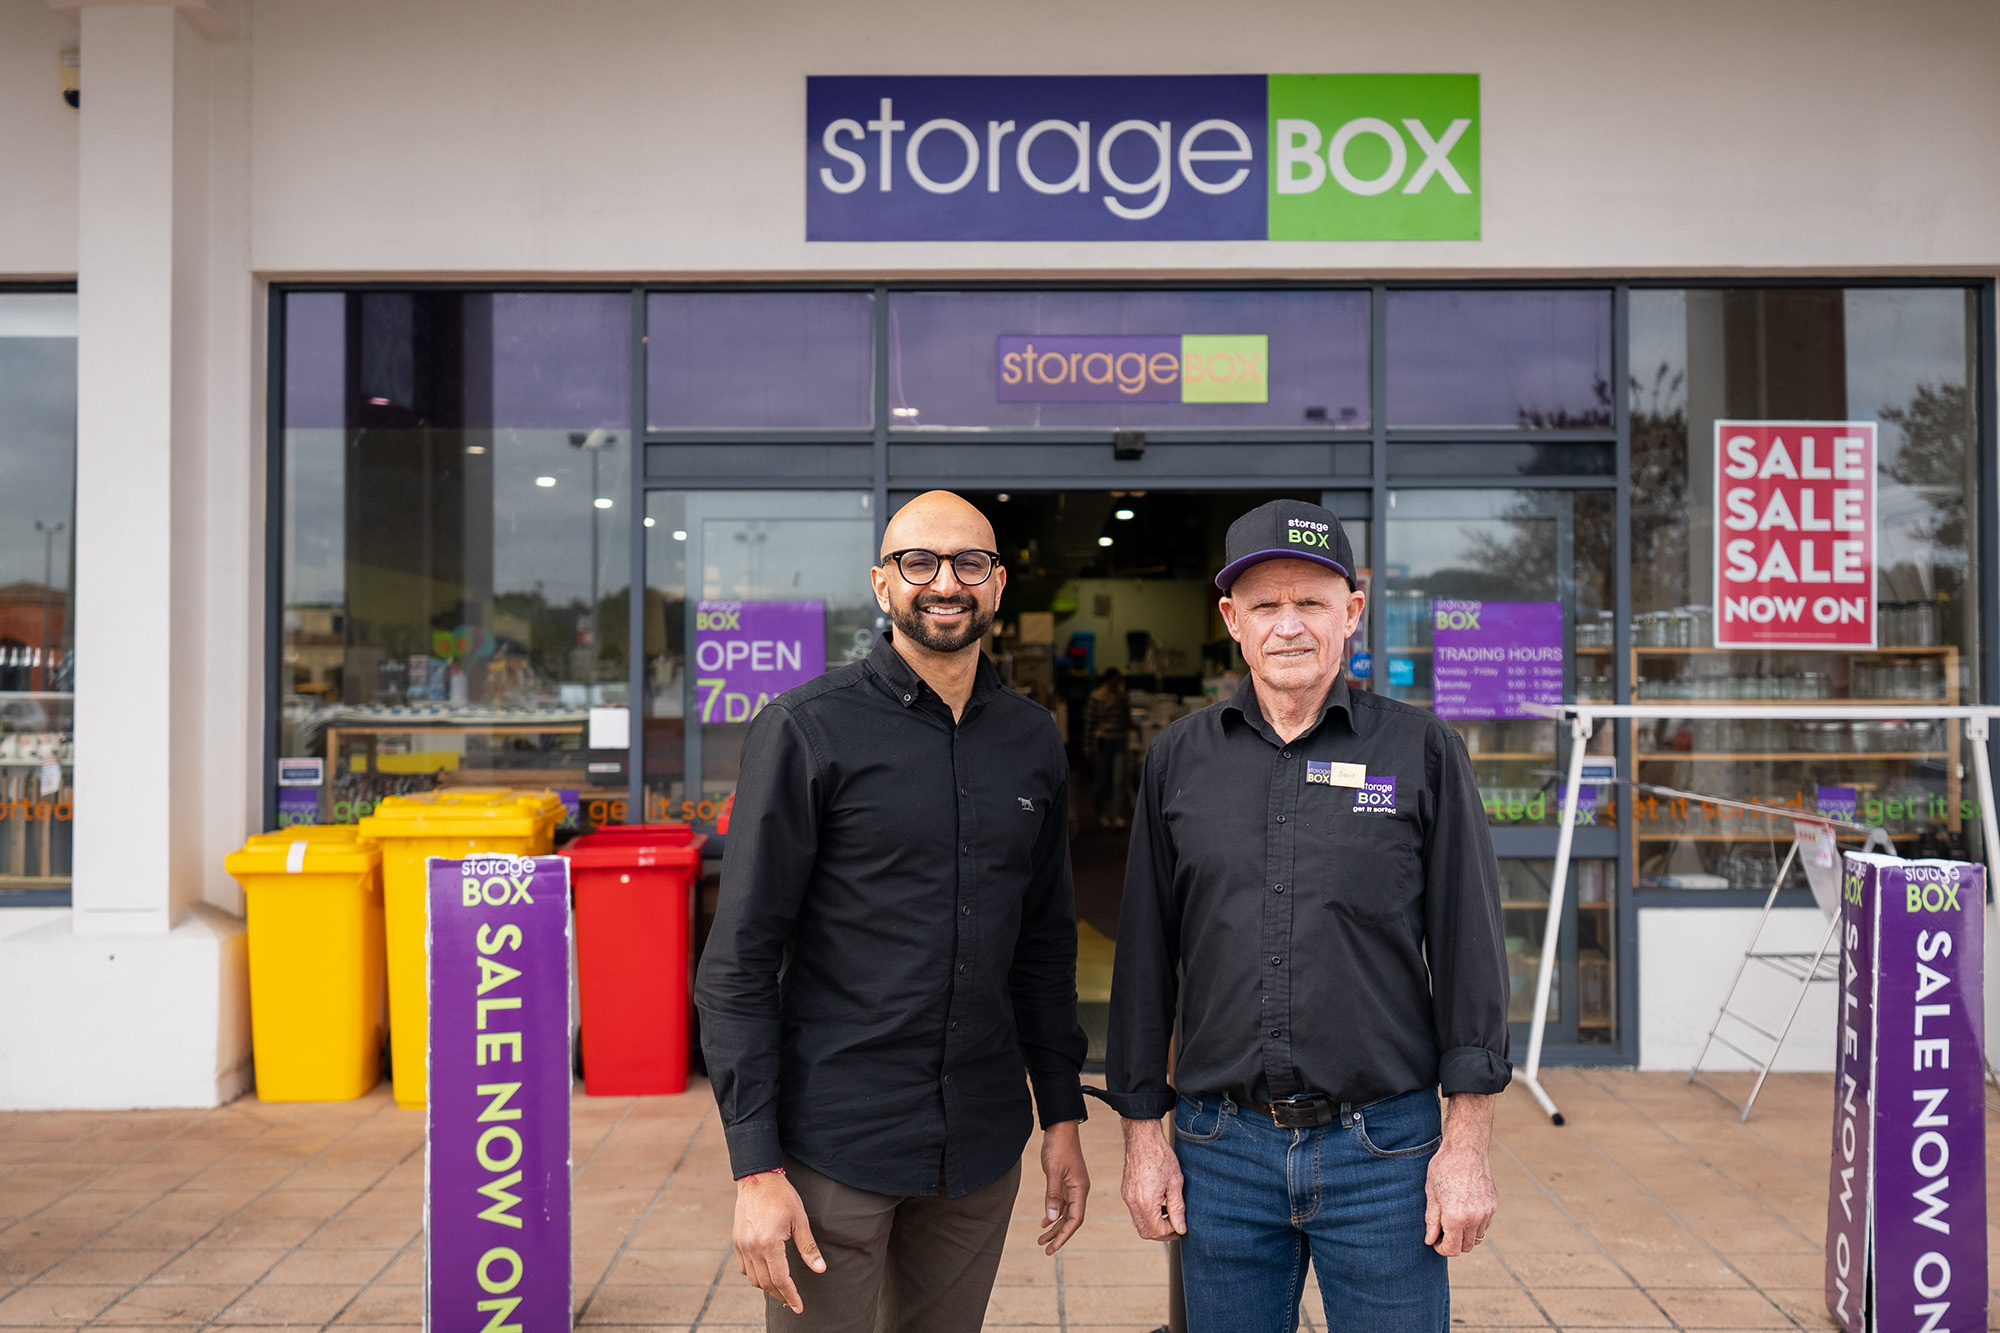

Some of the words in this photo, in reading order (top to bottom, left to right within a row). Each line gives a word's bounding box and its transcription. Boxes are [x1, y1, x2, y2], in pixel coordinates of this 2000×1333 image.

[819, 97, 1253, 220] storage
[1276, 117, 1473, 195] BOX
[1002, 344, 1179, 394] storage
[1184, 352, 1264, 384] BOX
[1724, 435, 1865, 480] SALE
[1724, 487, 1865, 531] SALE
[1288, 518, 1329, 532] storage
[1288, 529, 1330, 550] BOX
[1724, 538, 1865, 583] SALE
[696, 612, 741, 631] BOX
[1436, 610, 1480, 630] BOX
[1725, 595, 1807, 623] NOW
[1812, 596, 1865, 624] ON
[696, 640, 801, 671] OPEN
[1438, 647, 1505, 661] TRADING
[1508, 647, 1563, 661] HOURS
[1437, 667, 1468, 677] Monday
[1474, 667, 1499, 677] Friday
[1438, 681, 1471, 690] Saturday
[697, 678, 726, 723] 7
[1437, 694, 1466, 703] Sunday
[1308, 774, 1330, 784] BOX
[1362, 782, 1393, 793] torage
[333, 801, 381, 825] ge
[651, 793, 671, 820] it
[1358, 792, 1392, 805] BOX
[1671, 796, 1691, 820] it
[1864, 795, 1916, 827] get
[1928, 792, 1948, 820] it
[462, 858, 536, 878] storage
[1905, 866, 1960, 884] storage
[463, 876, 534, 907] BOX
[1845, 873, 1864, 908] BOX
[1906, 883, 1961, 913] BOX
[476, 923, 522, 1066] SALE
[1845, 919, 1859, 1062] SALE
[1913, 929, 1953, 1072] SALE
[476, 1082, 523, 1229] NOW
[1839, 1073, 1857, 1223] NOW
[1911, 1088, 1950, 1235] NOW
[476, 1246, 523, 1333] ON
[1835, 1232, 1850, 1325] ON
[1913, 1251, 1951, 1333] ON
